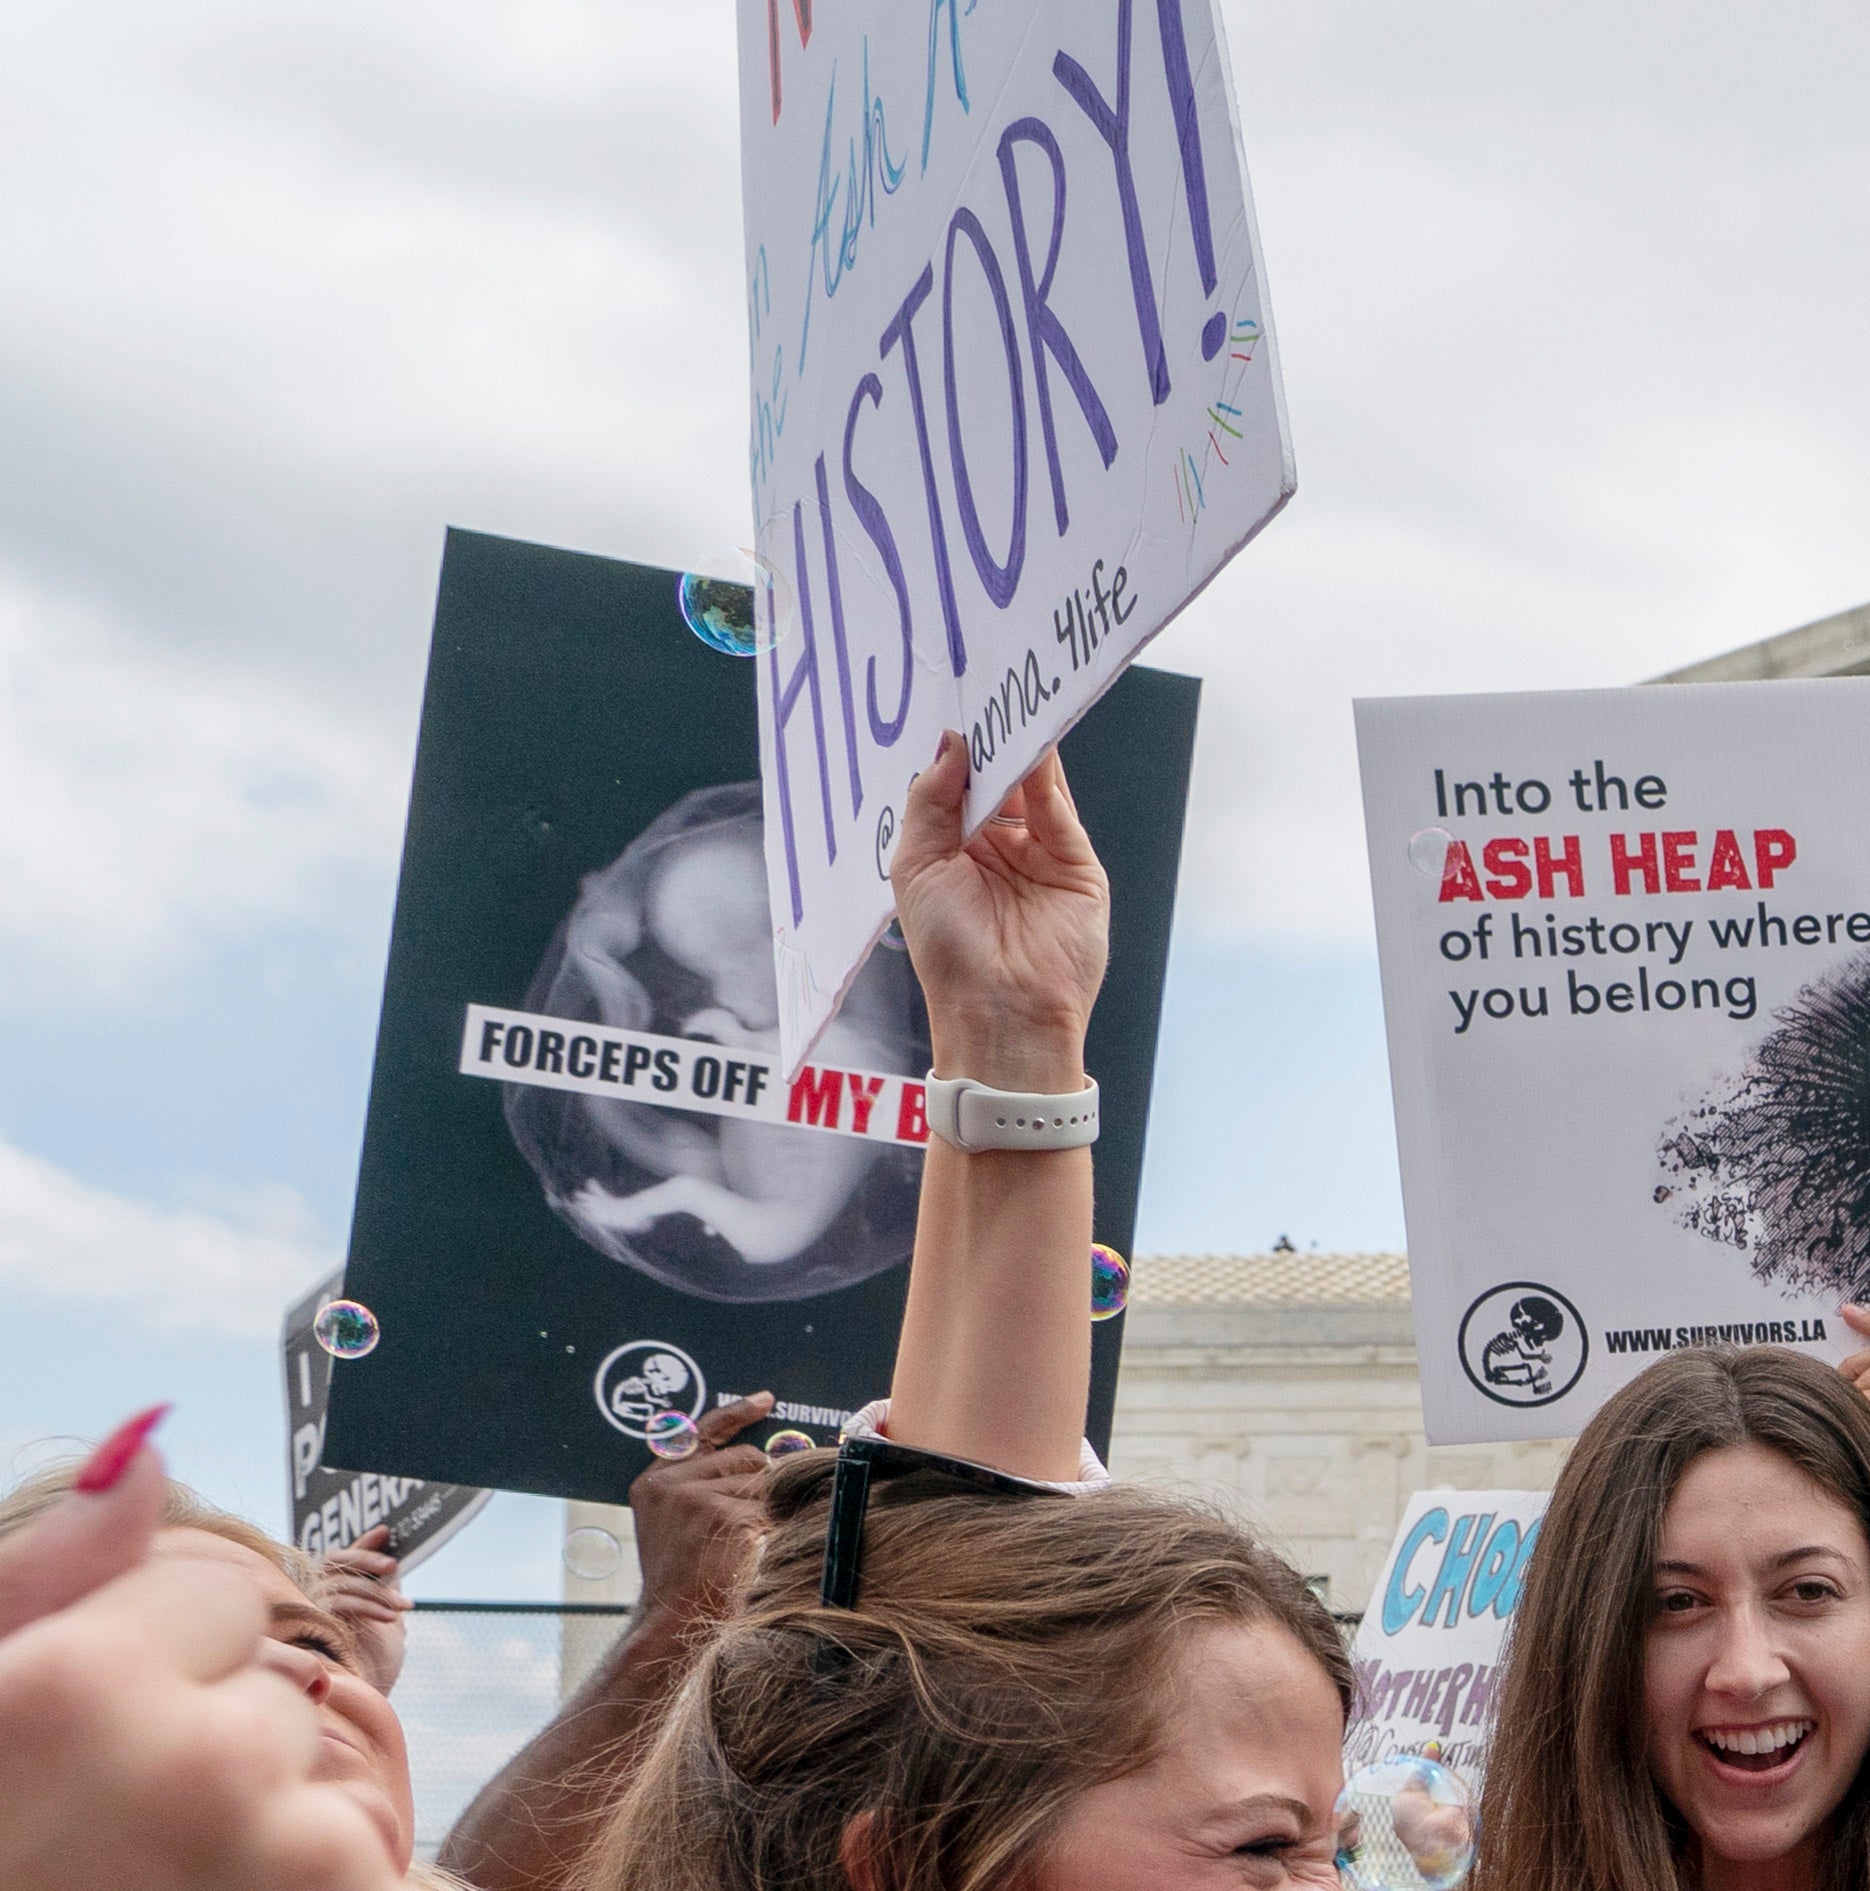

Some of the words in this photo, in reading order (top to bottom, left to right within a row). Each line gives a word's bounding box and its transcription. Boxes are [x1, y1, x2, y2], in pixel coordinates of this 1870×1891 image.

[1433, 769, 1552, 817] Into
[1568, 759, 1669, 812] the
[1437, 834, 1586, 903] ASH
[1608, 829, 1797, 896] HEAP
[1439, 913, 1494, 962] of
[1510, 907, 1694, 965] history
[1448, 985, 1550, 1034] you
[1566, 965, 1758, 1021] belong
[478, 1019, 680, 1093] FORCEPS
[691, 1055, 769, 1107] OFF
[786, 1065, 885, 1135] MY
